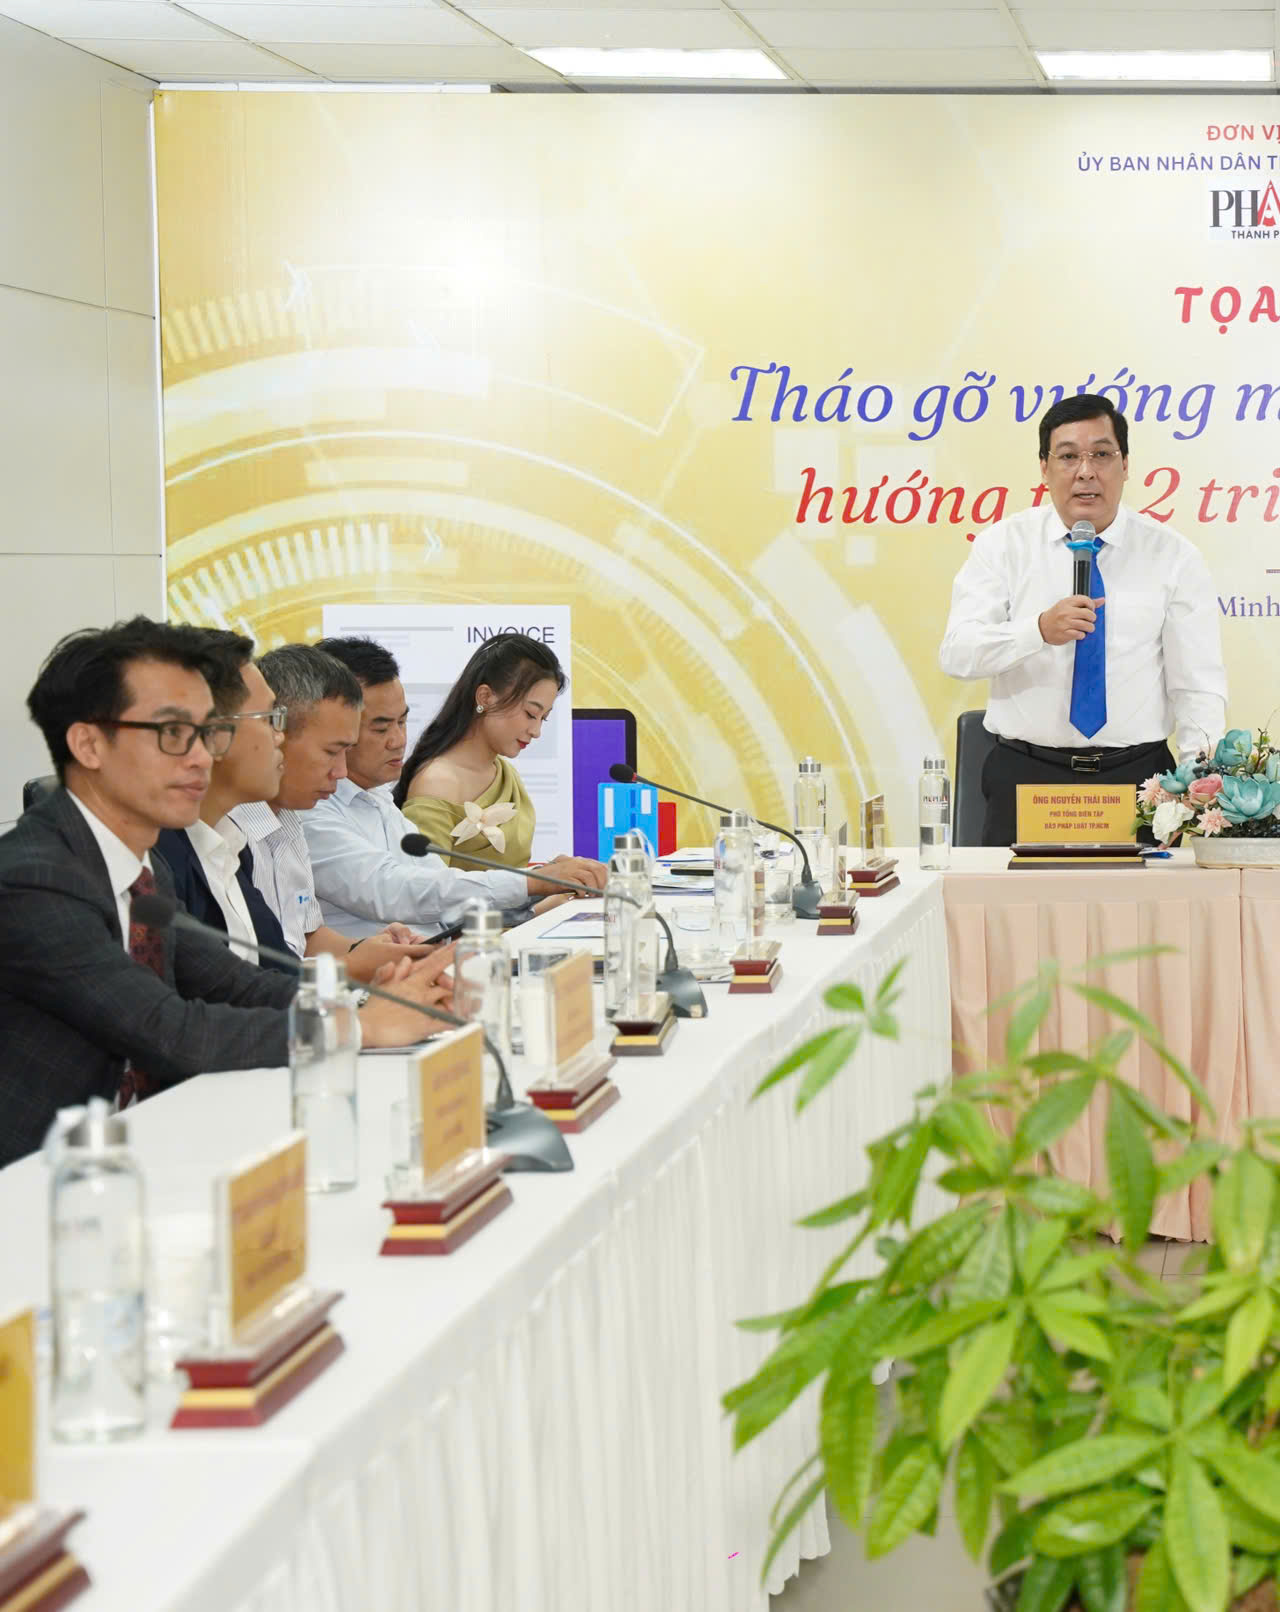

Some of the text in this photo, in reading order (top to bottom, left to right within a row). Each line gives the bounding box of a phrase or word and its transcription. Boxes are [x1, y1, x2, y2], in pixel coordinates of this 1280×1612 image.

[1206, 123, 1255, 141] ĐƠN
[1077, 151, 1104, 172] ỦY
[1109, 155, 1150, 172] BAN
[1156, 152, 1214, 171] NHÂN
[1220, 151, 1261, 171] DÂN
[1174, 285, 1280, 335] TỌA
[729, 361, 894, 424] Tháo
[907, 370, 997, 442] gỡ
[1138, 466, 1181, 524] 2
